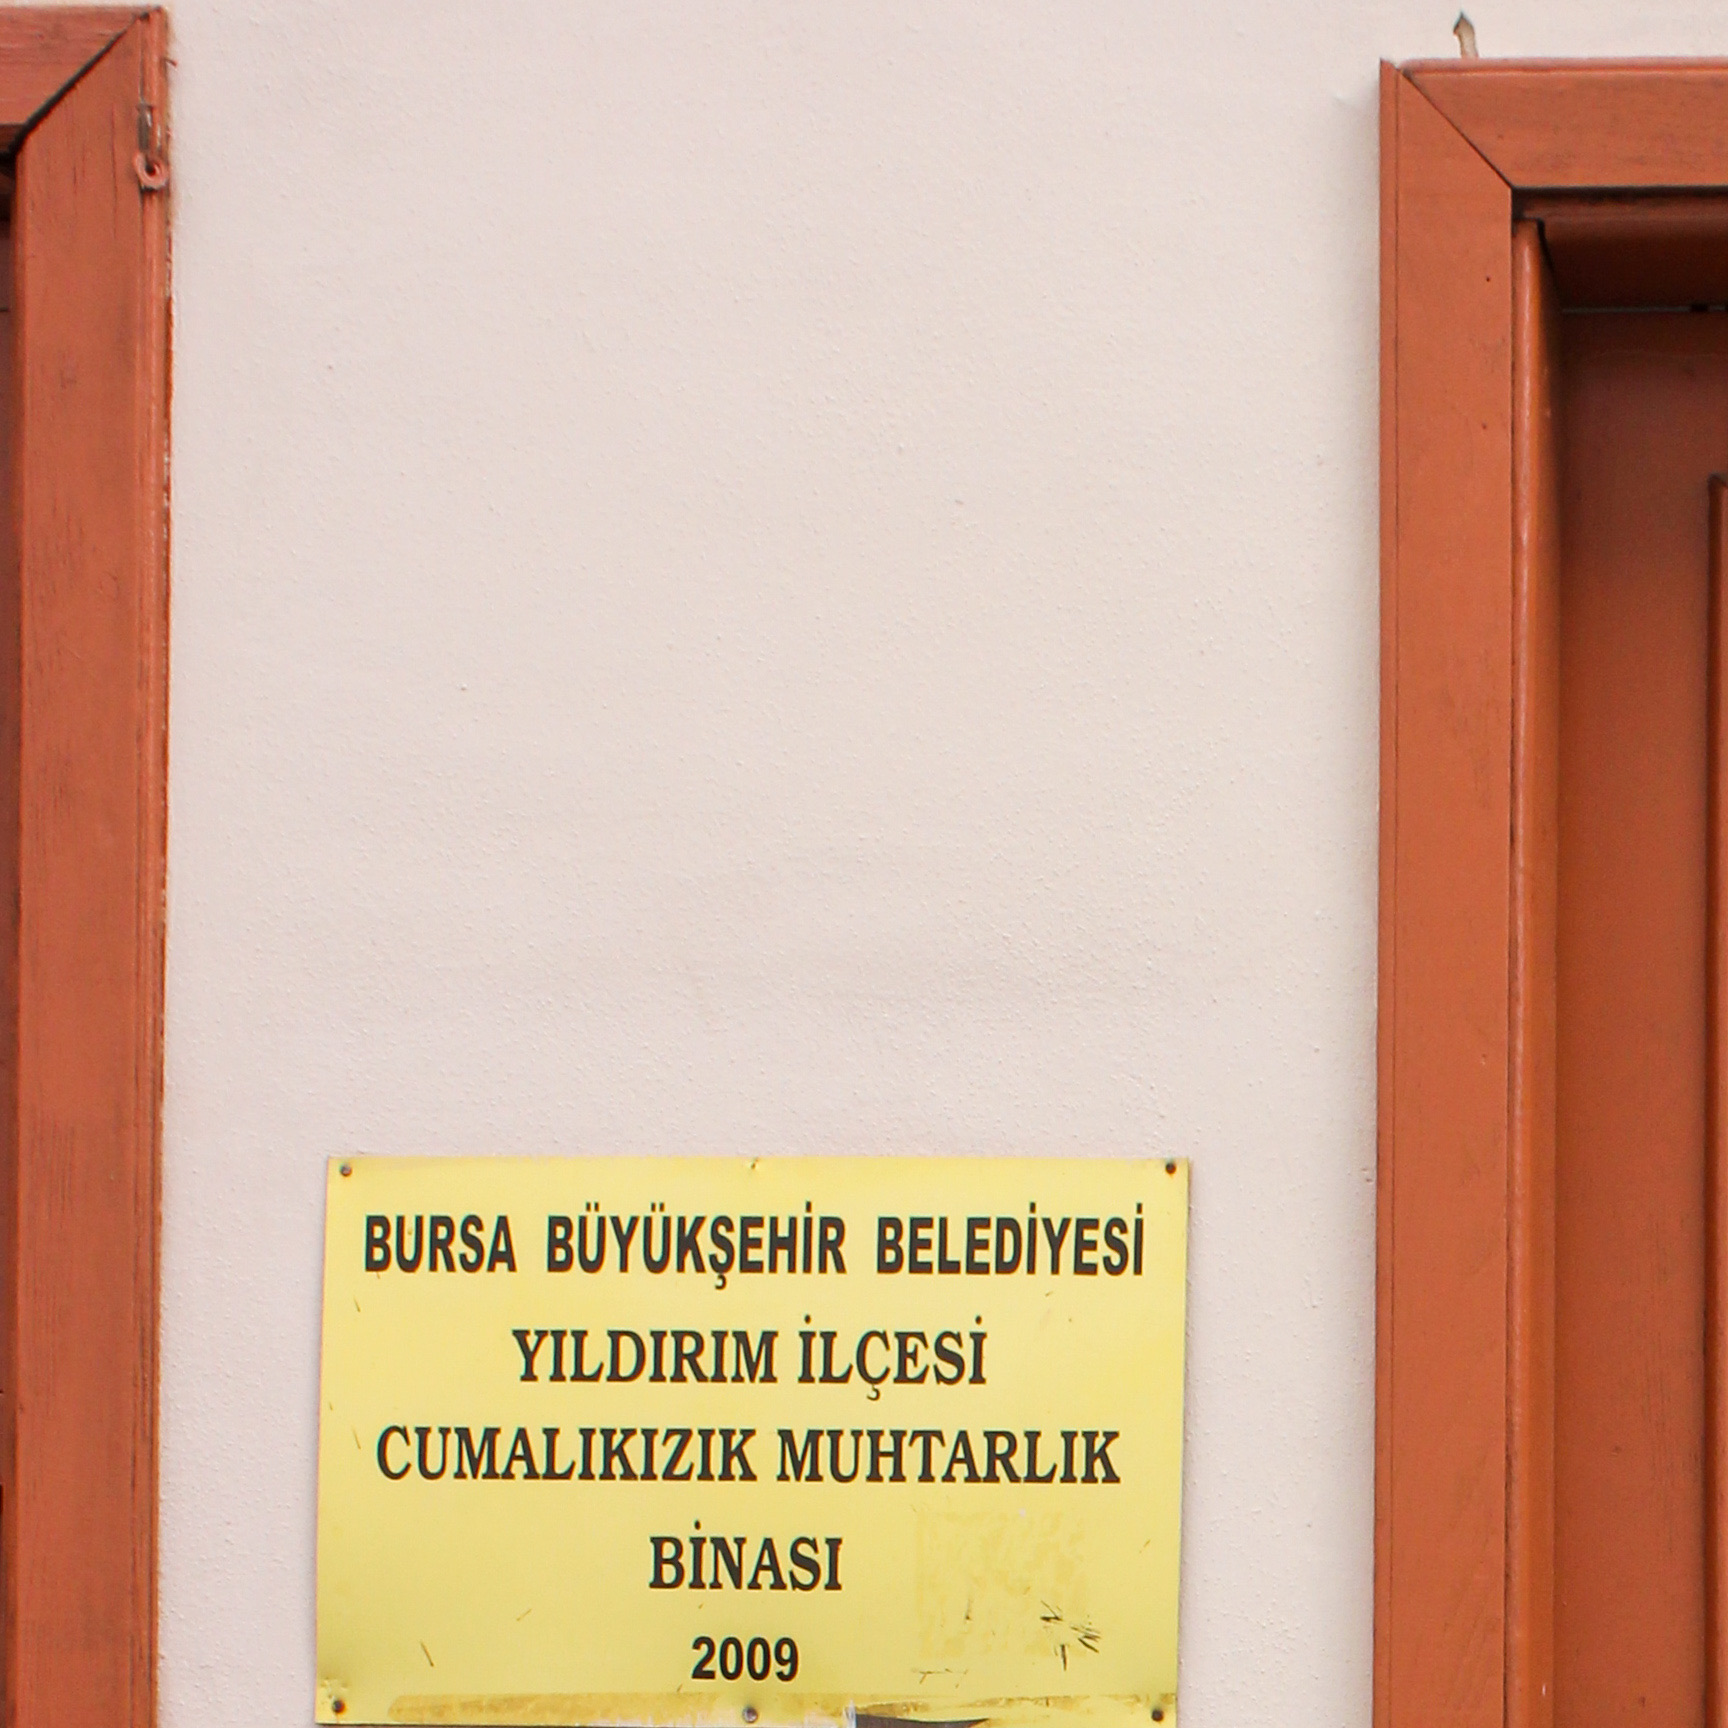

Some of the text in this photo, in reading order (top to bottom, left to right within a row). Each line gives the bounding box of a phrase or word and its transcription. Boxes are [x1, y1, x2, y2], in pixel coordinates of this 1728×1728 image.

[364, 1201, 1145, 1290] BURSA BÜYÜKŞEHİR BELEDİYESİ
[511, 1314, 988, 1401] YILDIRIM İLÇESİ
[375, 1425, 1122, 1485] CUMALIKIZIK MUHTARLIK
[647, 1520, 843, 1592] BİNASI
[690, 1635, 800, 1682] 2009
